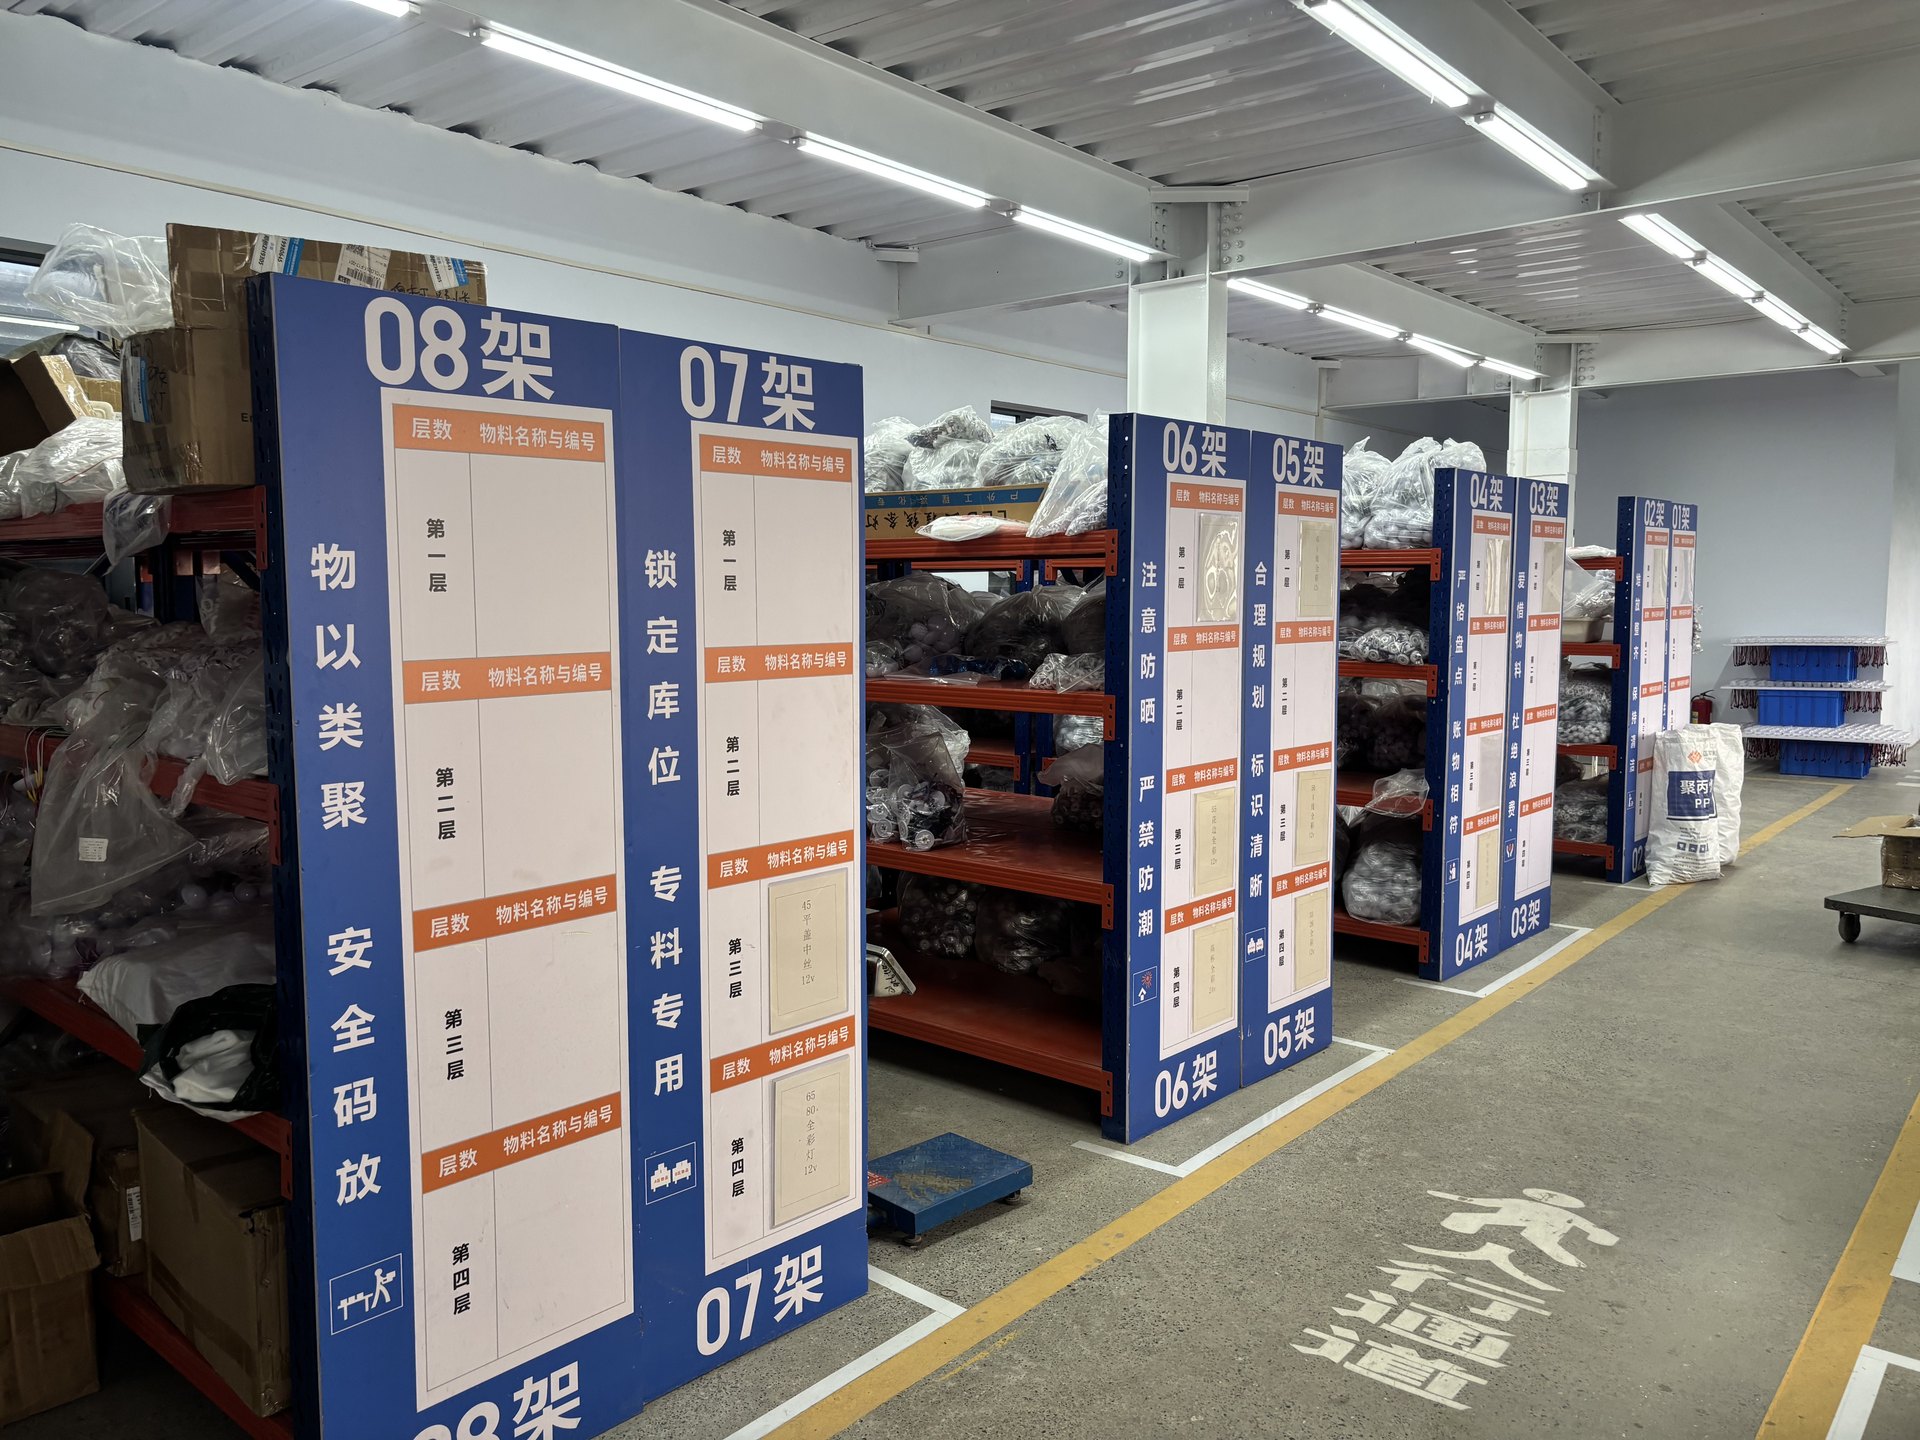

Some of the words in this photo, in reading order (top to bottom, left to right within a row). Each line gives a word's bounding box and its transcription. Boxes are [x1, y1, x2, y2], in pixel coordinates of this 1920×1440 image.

[365, 294, 554, 400] 08架
[680, 346, 815, 430] 07架
[412, 418, 451, 440] 层数
[480, 423, 595, 451] 物料名称与编号
[713, 446, 741, 464] 层数
[761, 450, 844, 473] 物料名称与编号
[1163, 422, 1226, 476] 06架
[1272, 437, 1324, 487] 05架
[1176, 490, 1190, 501] 层数
[1199, 492, 1239, 505] 物料名称与编号
[1283, 498, 1294, 509] 层数
[1302, 500, 1334, 512] 物料名称与编号
[1470, 473, 1503, 511] 04架
[1530, 482, 1558, 516] 03架
[1644, 500, 1664, 526] 02架
[1672, 505, 1690, 530] 01架
[427, 519, 447, 592] 第一层
[723, 530, 736, 590] 第一层
[1141, 562, 1156, 723] 注意防晒
[1174, 633, 1187, 645] 层数
[1196, 631, 1236, 644] 物料名称与编号
[1252, 562, 1267, 708] 合理规划
[1280, 627, 1292, 639] 层数
[1299, 626, 1331, 637] 物料名称与编号
[311, 544, 367, 829] 物以类聚
[422, 670, 461, 691] 层数
[489, 663, 602, 687] 物料名称与编号
[645, 550, 680, 785] 锁定库位
[718, 656, 745, 673] 层数
[765, 652, 846, 671] 物料名称与编号
[727, 736, 740, 796] 第二层
[1172, 774, 1185, 786] 层数
[1195, 765, 1234, 781] 物料名称与编号
[1277, 754, 1290, 766] 层数
[1297, 748, 1329, 762] 物料名称与编号
[436, 768, 456, 839] 第二层
[1250, 754, 1264, 897] 标识清晰
[1695, 798, 1710, 809] PP
[720, 858, 748, 877] 层数
[768, 840, 847, 869] 物料名称与编号
[1139, 776, 1154, 937] 严禁防潮
[1276, 878, 1288, 890] 层数
[1295, 869, 1327, 885] 物料名称与编号
[431, 913, 469, 938] 层数
[496, 886, 607, 925] 物料名称与编号
[1171, 912, 1184, 925] 层数
[1193, 897, 1232, 917] 物料名称与编号
[1512, 899, 1540, 938] 03架
[729, 938, 742, 998] 第三层
[1456, 924, 1487, 967] 04架
[650, 866, 683, 1095] 专料专用
[445, 1009, 464, 1080] 第三层
[723, 1058, 750, 1080] 层数
[770, 1026, 848, 1065] 物料名称与编号
[1264, 1007, 1314, 1065] 05架
[328, 927, 381, 1205] 安全码放
[1155, 1050, 1217, 1117] 06架
[440, 1149, 477, 1177] 层数
[504, 1105, 612, 1155] 物料名称与编号
[732, 1138, 744, 1197] 第四层
[452, 1243, 470, 1314] 第四层
[697, 1245, 824, 1358] 07架
